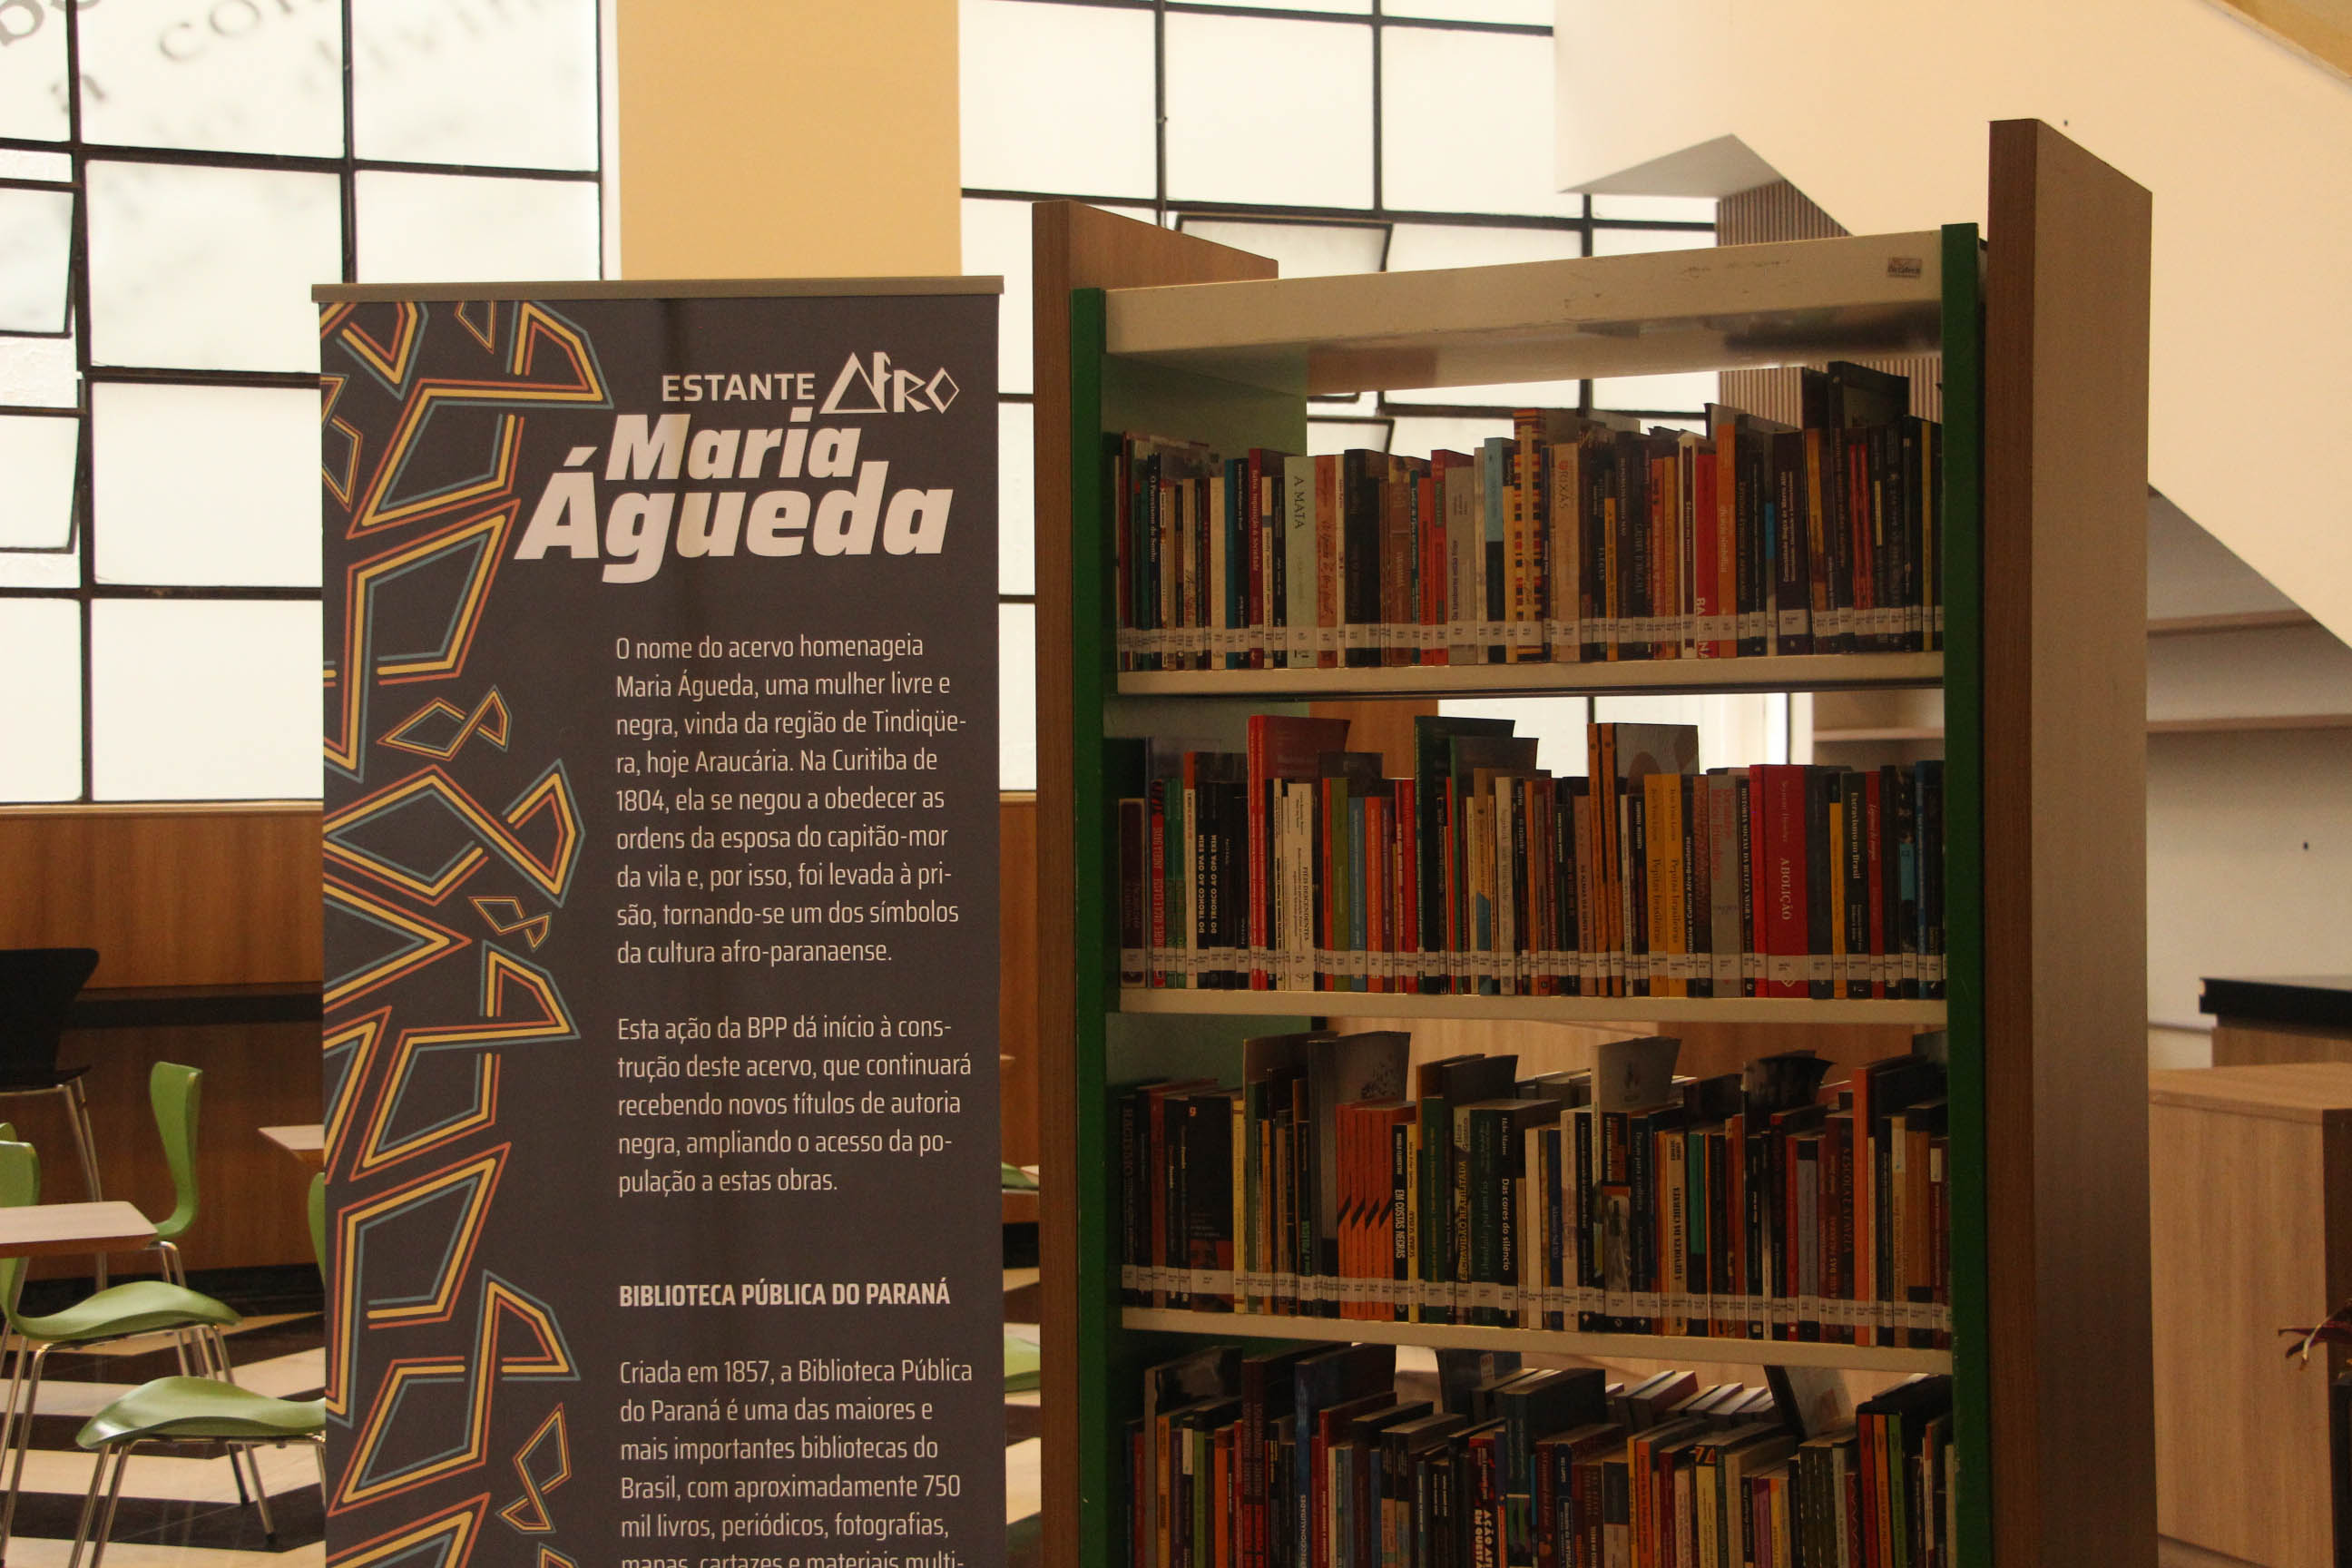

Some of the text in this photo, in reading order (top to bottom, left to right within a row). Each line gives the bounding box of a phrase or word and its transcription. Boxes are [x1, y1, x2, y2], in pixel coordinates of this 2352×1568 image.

[662, 373, 816, 402] ESTANTE
[604, 407, 861, 481] Maria
[514, 446, 954, 584] Águeda
[1294, 475, 1306, 529] A MATA
[616, 632, 923, 662] O nome do acervo homenageia
[617, 669, 950, 701] Maria Águeda, uma mulher livre e
[617, 709, 965, 740] negra, vinda da região de Tindiqüe-
[617, 747, 936, 778] ra, hoje Araucária. Na Curitiba de
[617, 786, 944, 815] 1804, ela se negou a obedecer as
[1850, 792, 1859, 840] Escravismo
[617, 824, 948, 853] ordens da esposa do capitão-mor
[617, 861, 951, 891] da vila e, por isso, foi levada à pri-
[1198, 874, 1205, 886] AO
[1852, 855, 1861, 878] Brasil
[1779, 858, 1793, 920] ABOLIÇÃO
[617, 899, 958, 928] são, tornando-se um dos símbolos
[1198, 921, 1205, 933] DO
[618, 939, 891, 967] da cultura afro-paranaense.
[619, 1014, 951, 1044] Esta ação da BPP dá início à cons-
[618, 1053, 971, 1083] trução deste acervo, que continuará
[619, 1091, 960, 1116] recebendo novos títulos de autoria
[619, 1129, 952, 1159] negra, ampliando o acesso da po-
[620, 1168, 837, 1198] pulação a estas obras.
[1502, 1178, 1511, 1195] Das
[1395, 1189, 1406, 1259] EM COSTAS NEGRAS
[1503, 1222, 1511, 1235] do
[1503, 1236, 1512, 1271] silêncio
[620, 1277, 950, 1307] BIBLIOTECA PÚBLICA DO PARANÁ
[621, 1357, 972, 1385] Criada em 1857, a Biblioteca Pública
[621, 1396, 932, 1422] do Paraná é uma das maiores e
[622, 1435, 937, 1465] mais importantes bibliotecas do
[622, 1474, 960, 1503] Brasil, com aproximadamente 750
[622, 1512, 948, 1542] mil livros, periódicos, fotografias,
[701, 1554, 782, 1568] cartazes
[789, 1558, 799, 1568] e
[808, 1551, 898, 1568] materiais
